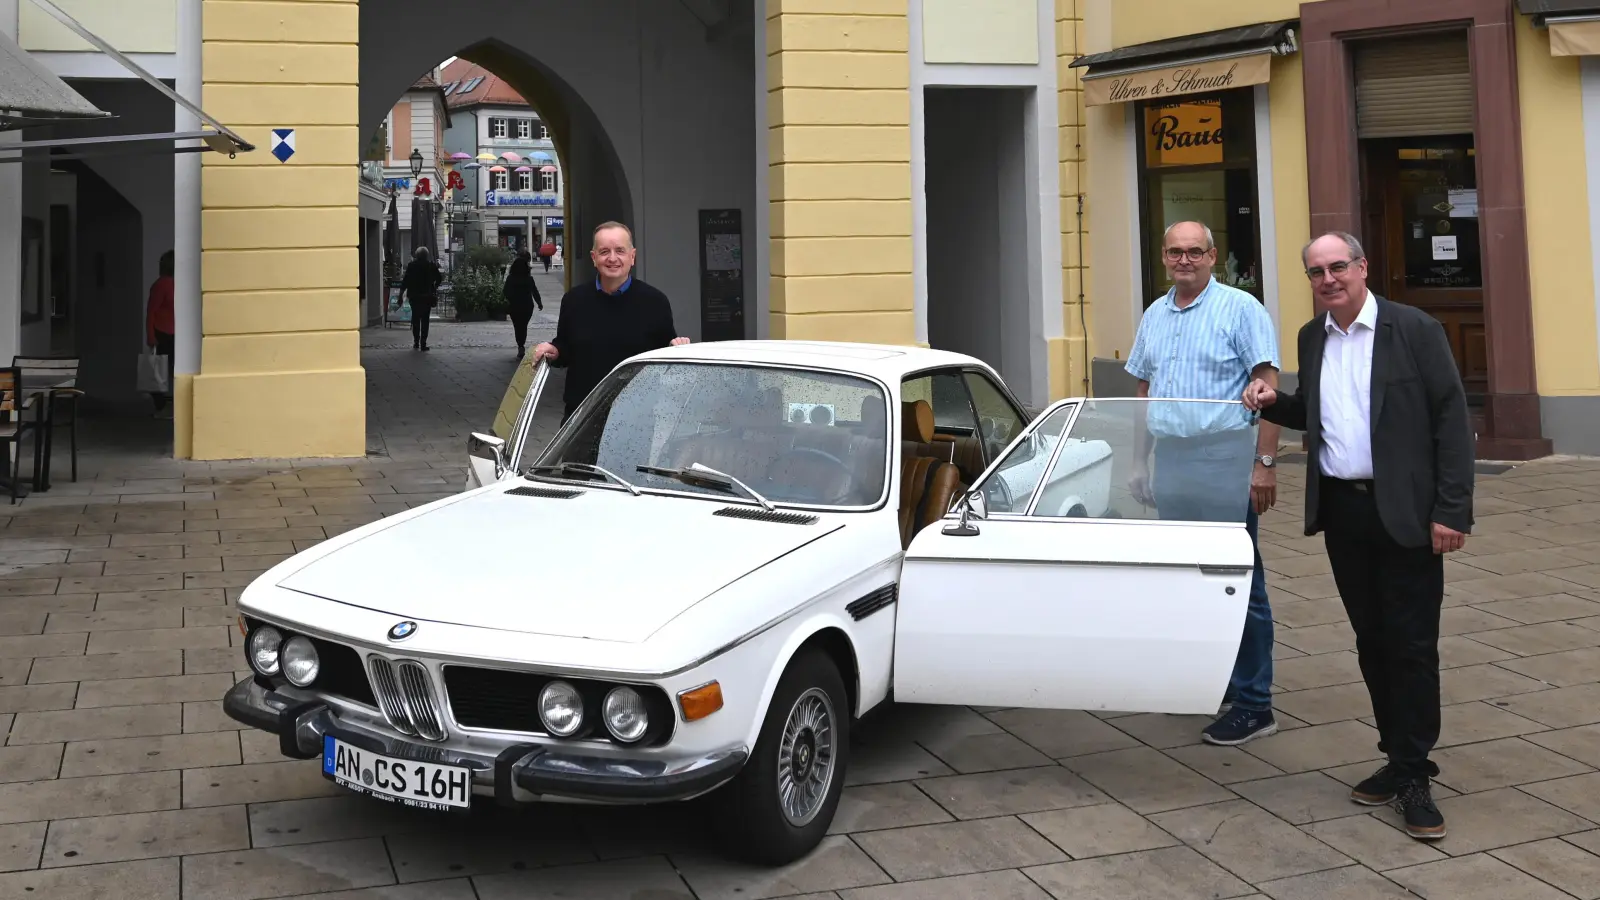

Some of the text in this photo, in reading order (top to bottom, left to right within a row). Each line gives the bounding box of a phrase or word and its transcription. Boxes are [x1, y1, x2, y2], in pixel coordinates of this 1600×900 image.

[1110, 63, 1239, 101] Uhren & Schmuck
[500, 196, 556, 206] Buchhandlung
[327, 758, 332, 766] D
[336, 745, 466, 802] AN CS 16H
[372, 791, 395, 803] Ansbach
